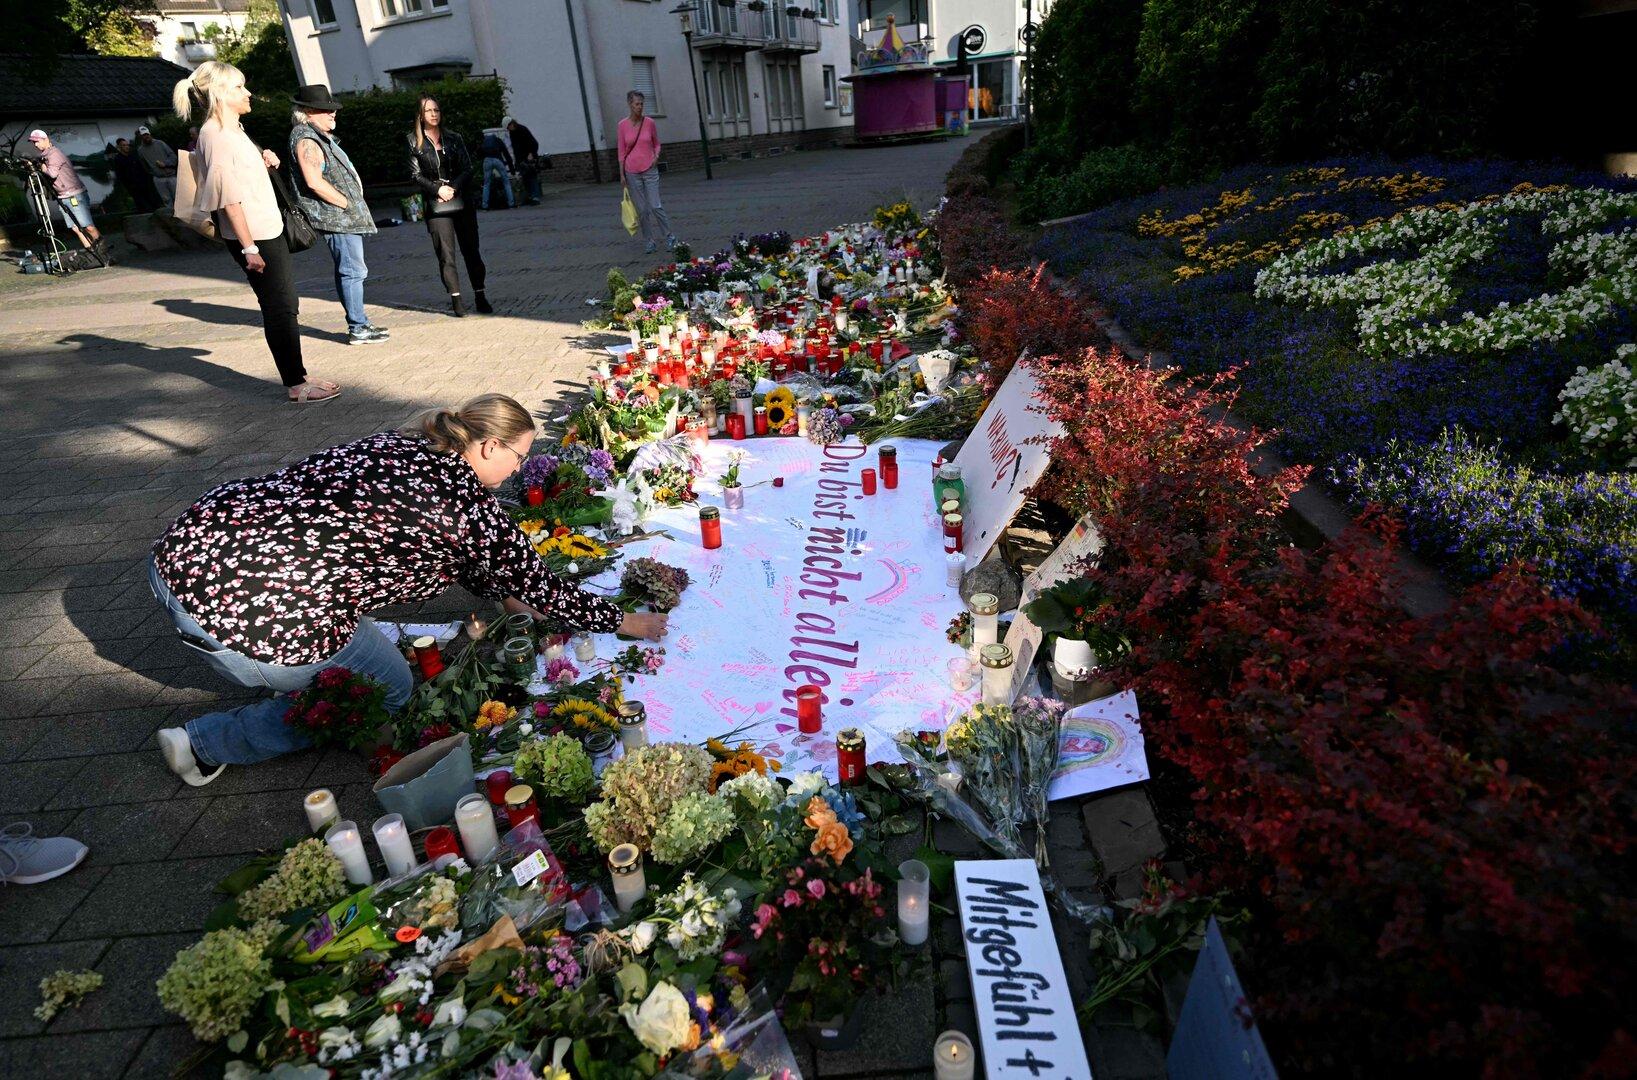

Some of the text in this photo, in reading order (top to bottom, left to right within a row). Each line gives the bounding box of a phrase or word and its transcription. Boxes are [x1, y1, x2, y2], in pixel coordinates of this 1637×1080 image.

[819, 444, 867, 473] Du
[812, 479, 863, 521] bist
[798, 526, 862, 606] nicht
[965, 877, 1057, 1077] Mitgefühl +
